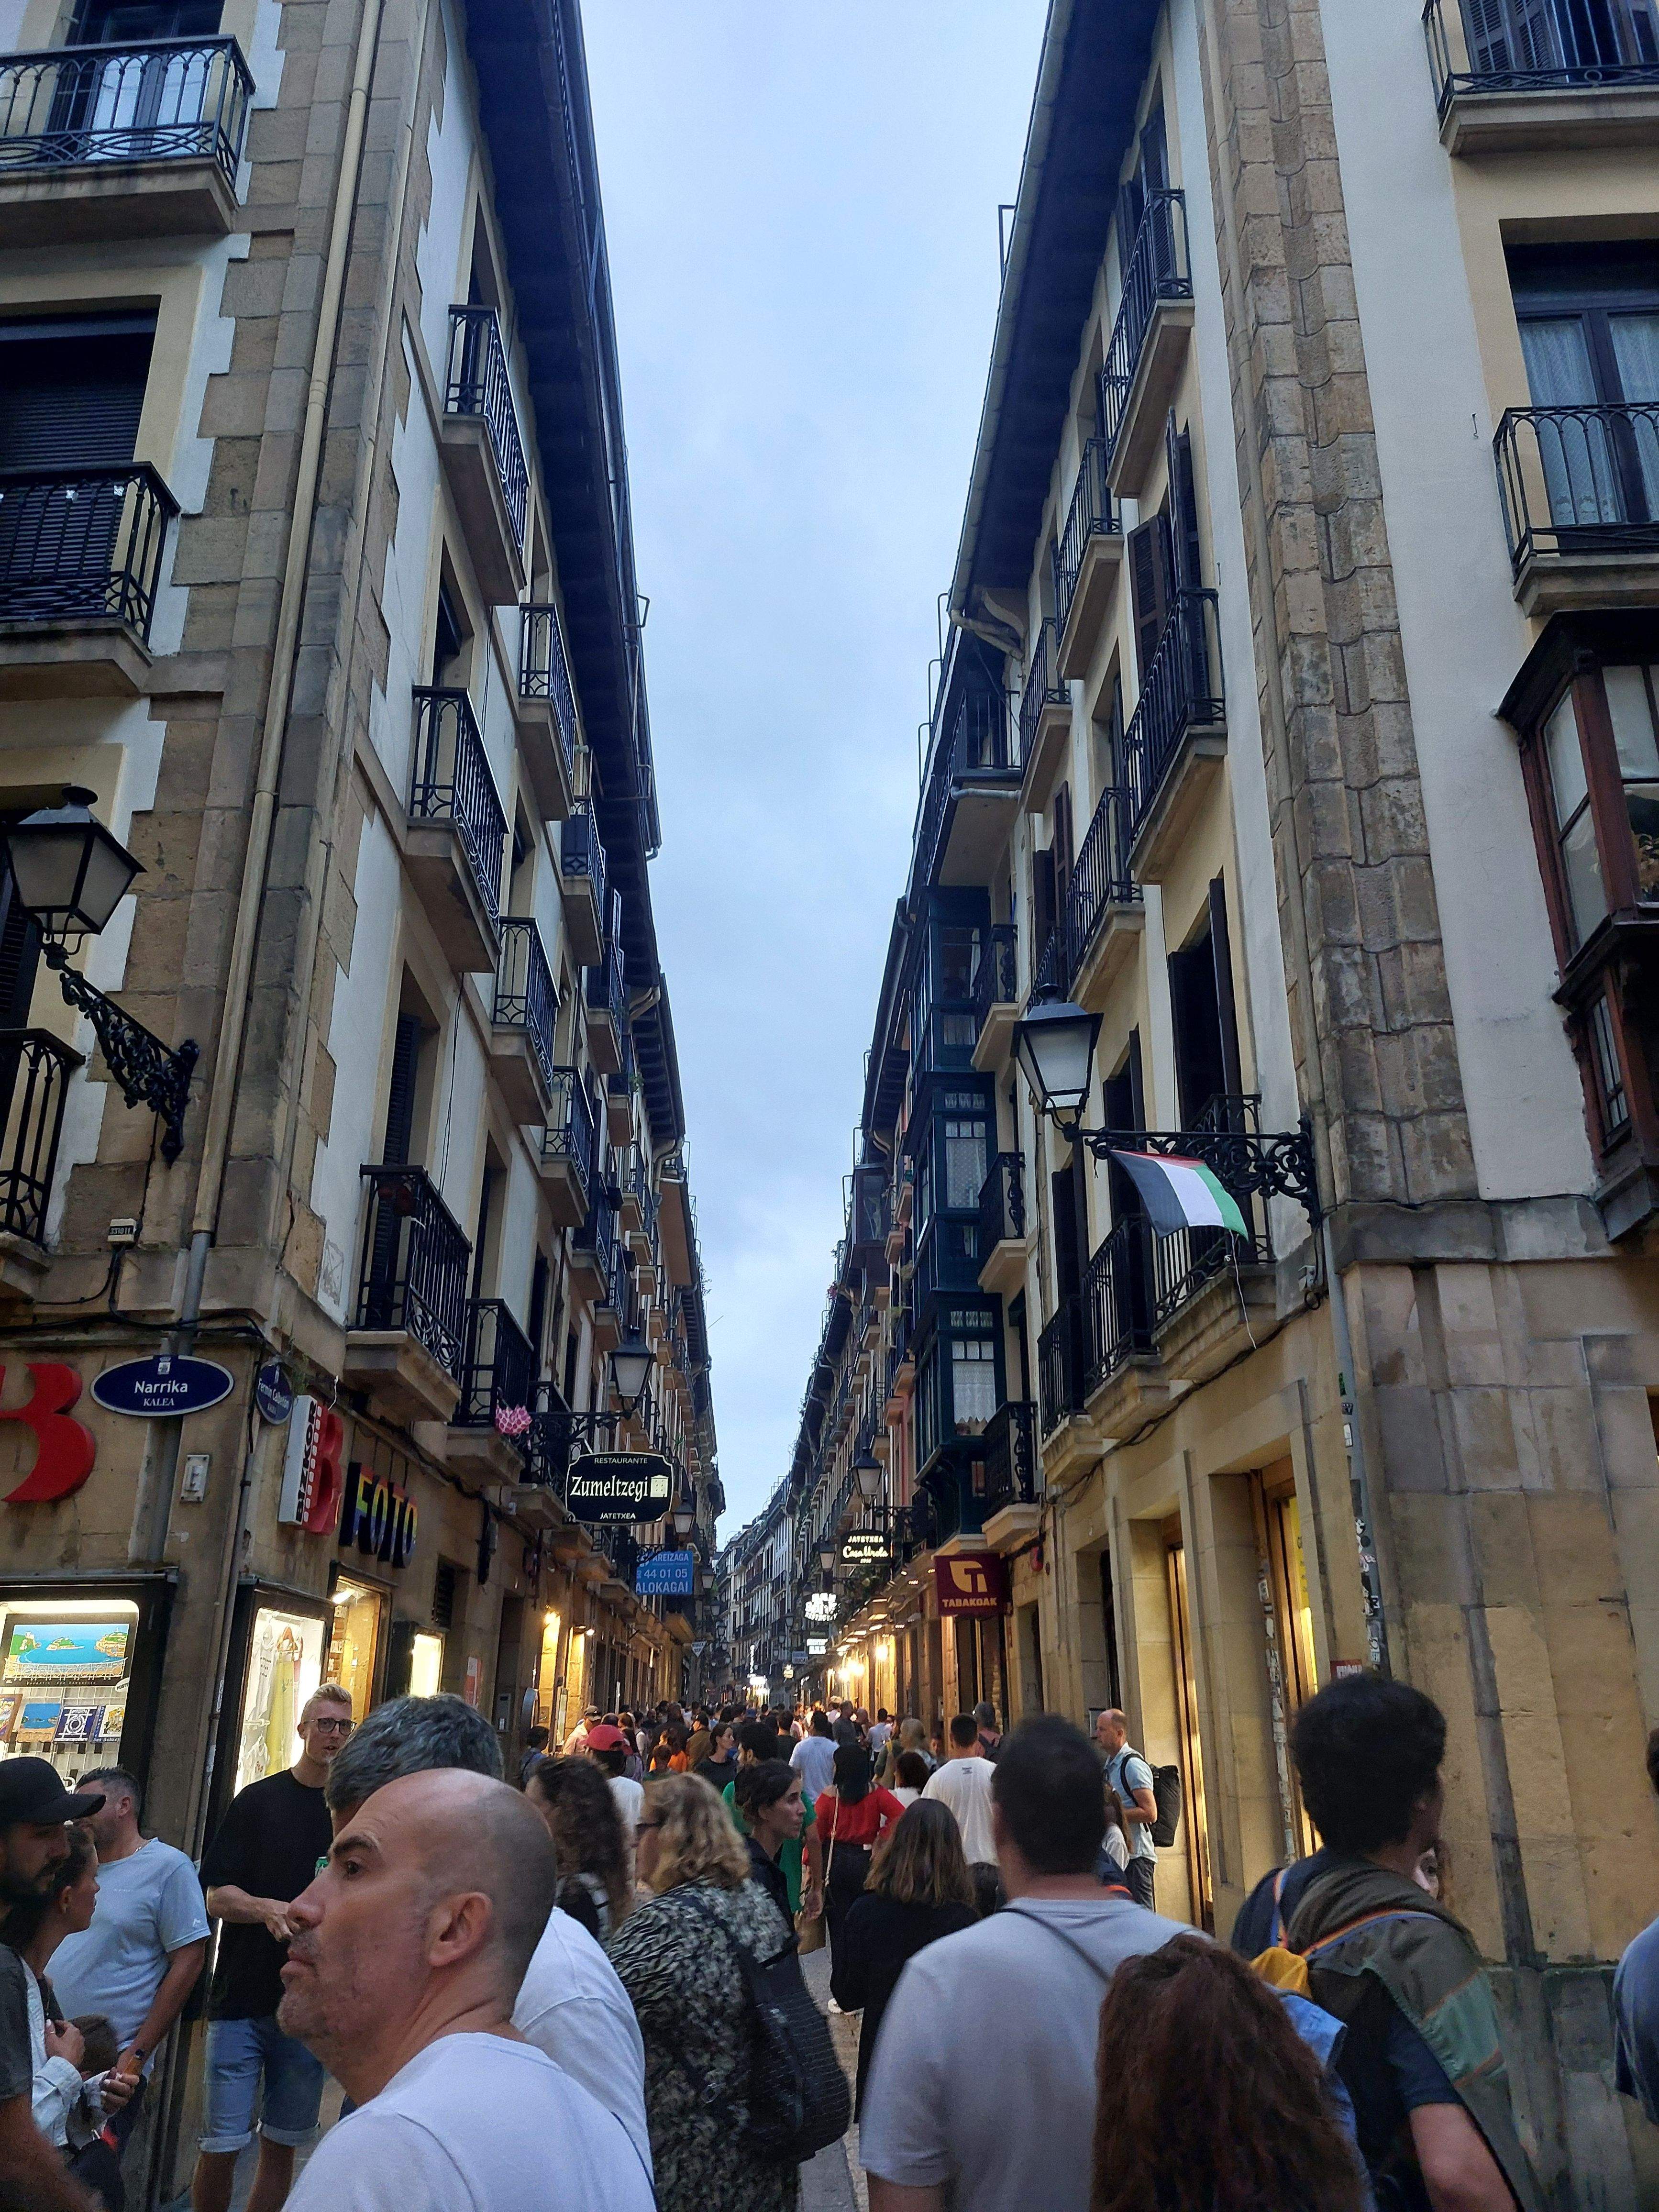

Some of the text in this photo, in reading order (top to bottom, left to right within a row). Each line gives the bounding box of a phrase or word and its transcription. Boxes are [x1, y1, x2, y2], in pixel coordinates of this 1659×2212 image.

[134, 1380, 188, 1394] Narrika
[143, 1398, 175, 1406] KALEA
[295, 1400, 317, 1522] BIZKOR
[569, 1474, 648, 1502] Zumeltzegi
[339, 1462, 419, 1569] FOTO
[652, 1553, 689, 1562] AREIZAGA
[643, 1569, 657, 1579] 44
[659, 1568, 671, 1579] 01
[675, 1568, 688, 1579] 05
[635, 1581, 688, 1593] ALOKAGAI
[941, 1597, 997, 1608] TABAKOAK
